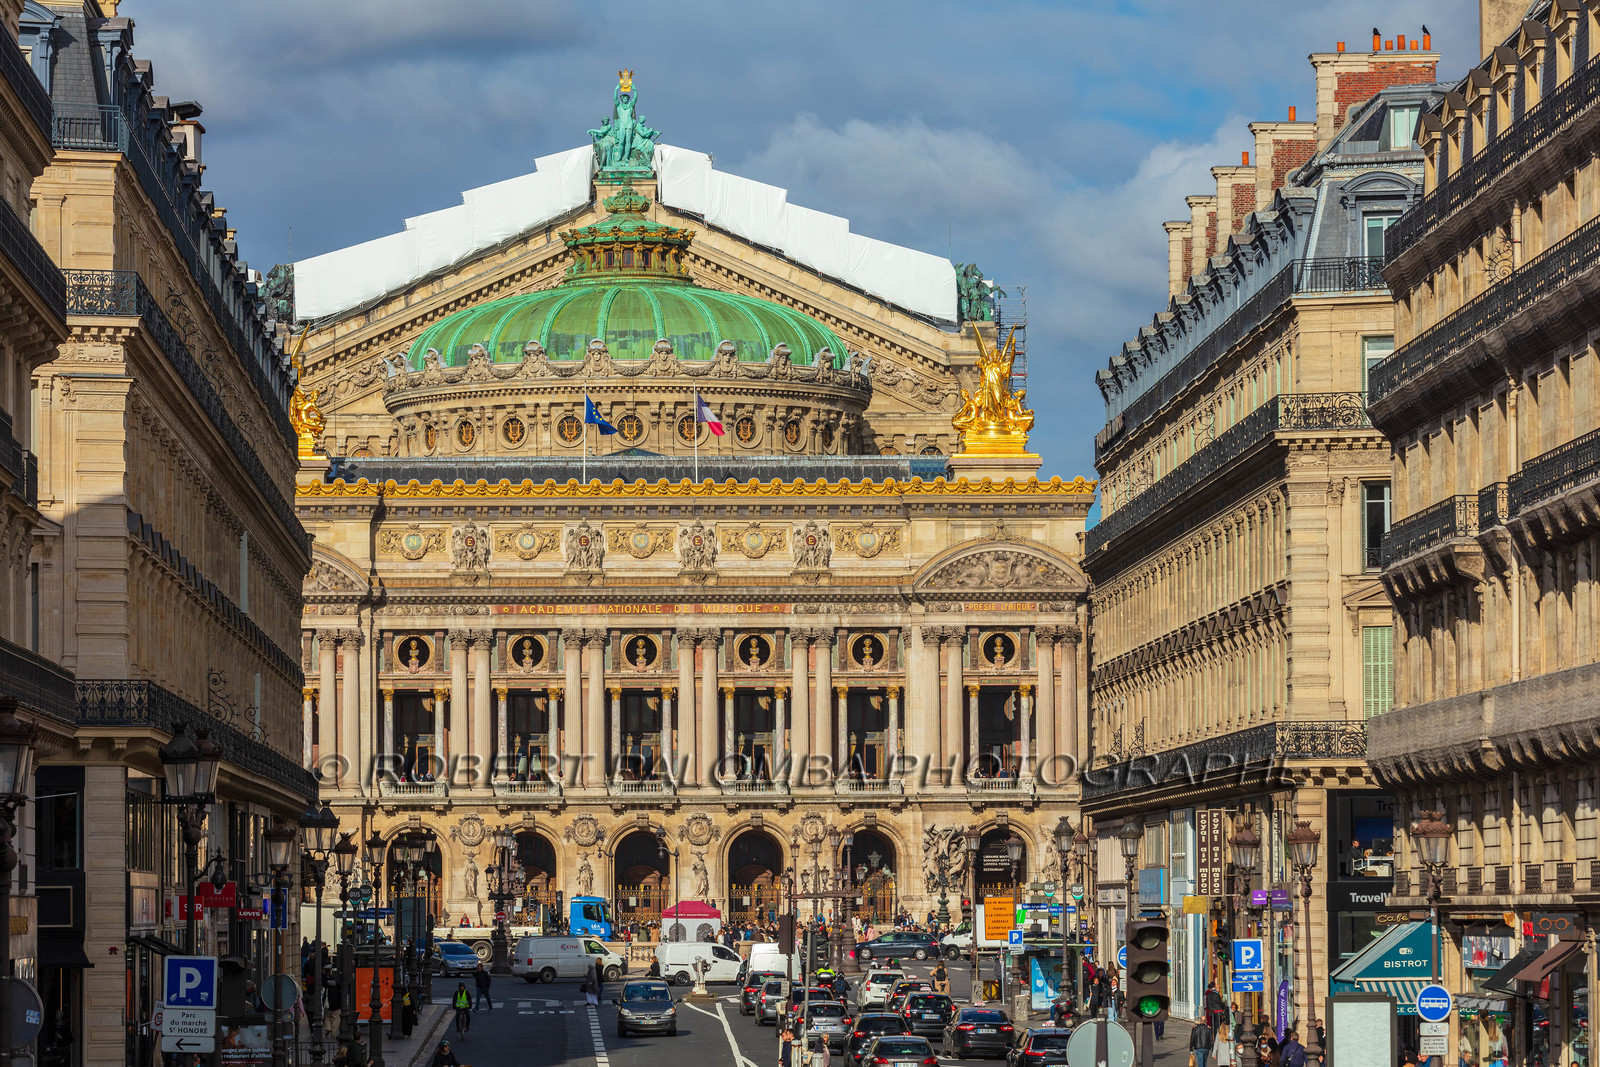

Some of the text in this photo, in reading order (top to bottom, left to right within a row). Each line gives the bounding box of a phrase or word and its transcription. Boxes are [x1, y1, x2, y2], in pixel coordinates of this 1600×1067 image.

[520, 604, 762, 614] ACADEMIE NATIONALE DE MUSIQUE
[1001, 603, 1032, 611] LYRIQUE
[1199, 867, 1208, 894] maroc
[1211, 867, 1220, 894] maroc
[184, 903, 203, 912] SR
[1377, 913, 1408, 923] Café
[1383, 959, 1428, 969] BISTROT
[179, 966, 202, 999] P
[177, 1026, 208, 1034] HONORÉ
